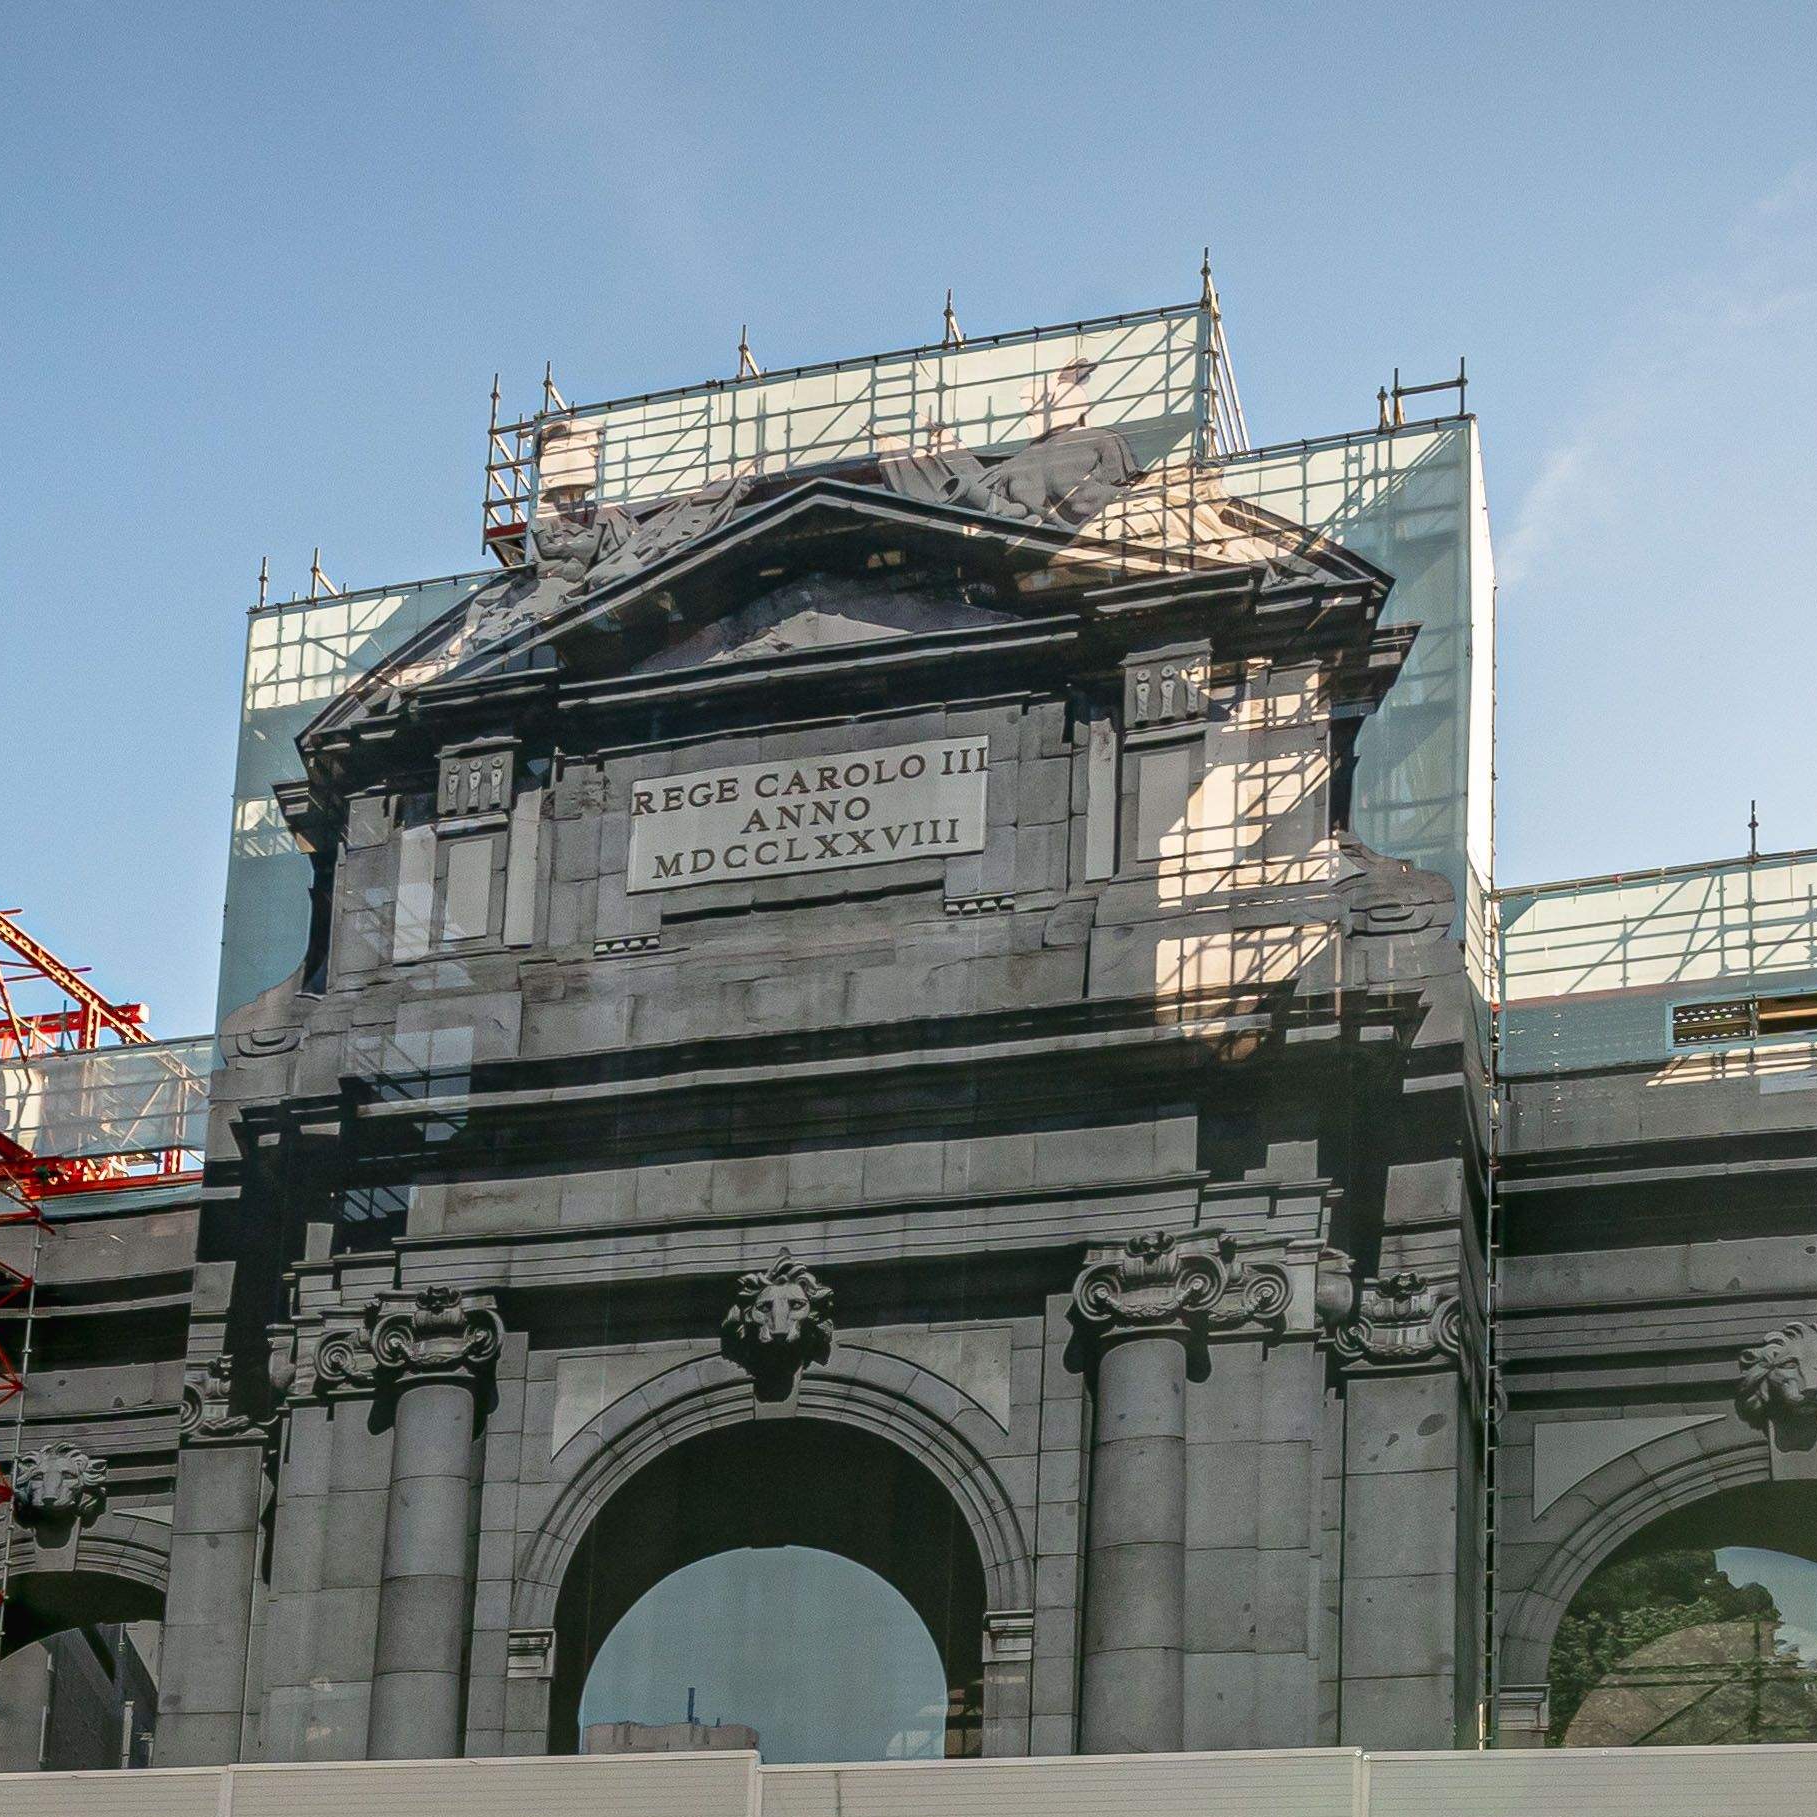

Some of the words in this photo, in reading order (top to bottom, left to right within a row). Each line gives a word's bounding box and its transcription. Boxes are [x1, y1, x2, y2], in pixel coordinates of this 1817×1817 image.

[631, 778, 740, 816] REGE
[754, 754, 926, 798] CAROLO
[940, 747, 990, 776] III
[740, 796, 871, 834] ANNO
[651, 818, 960, 879] MDCCLXXVIII
